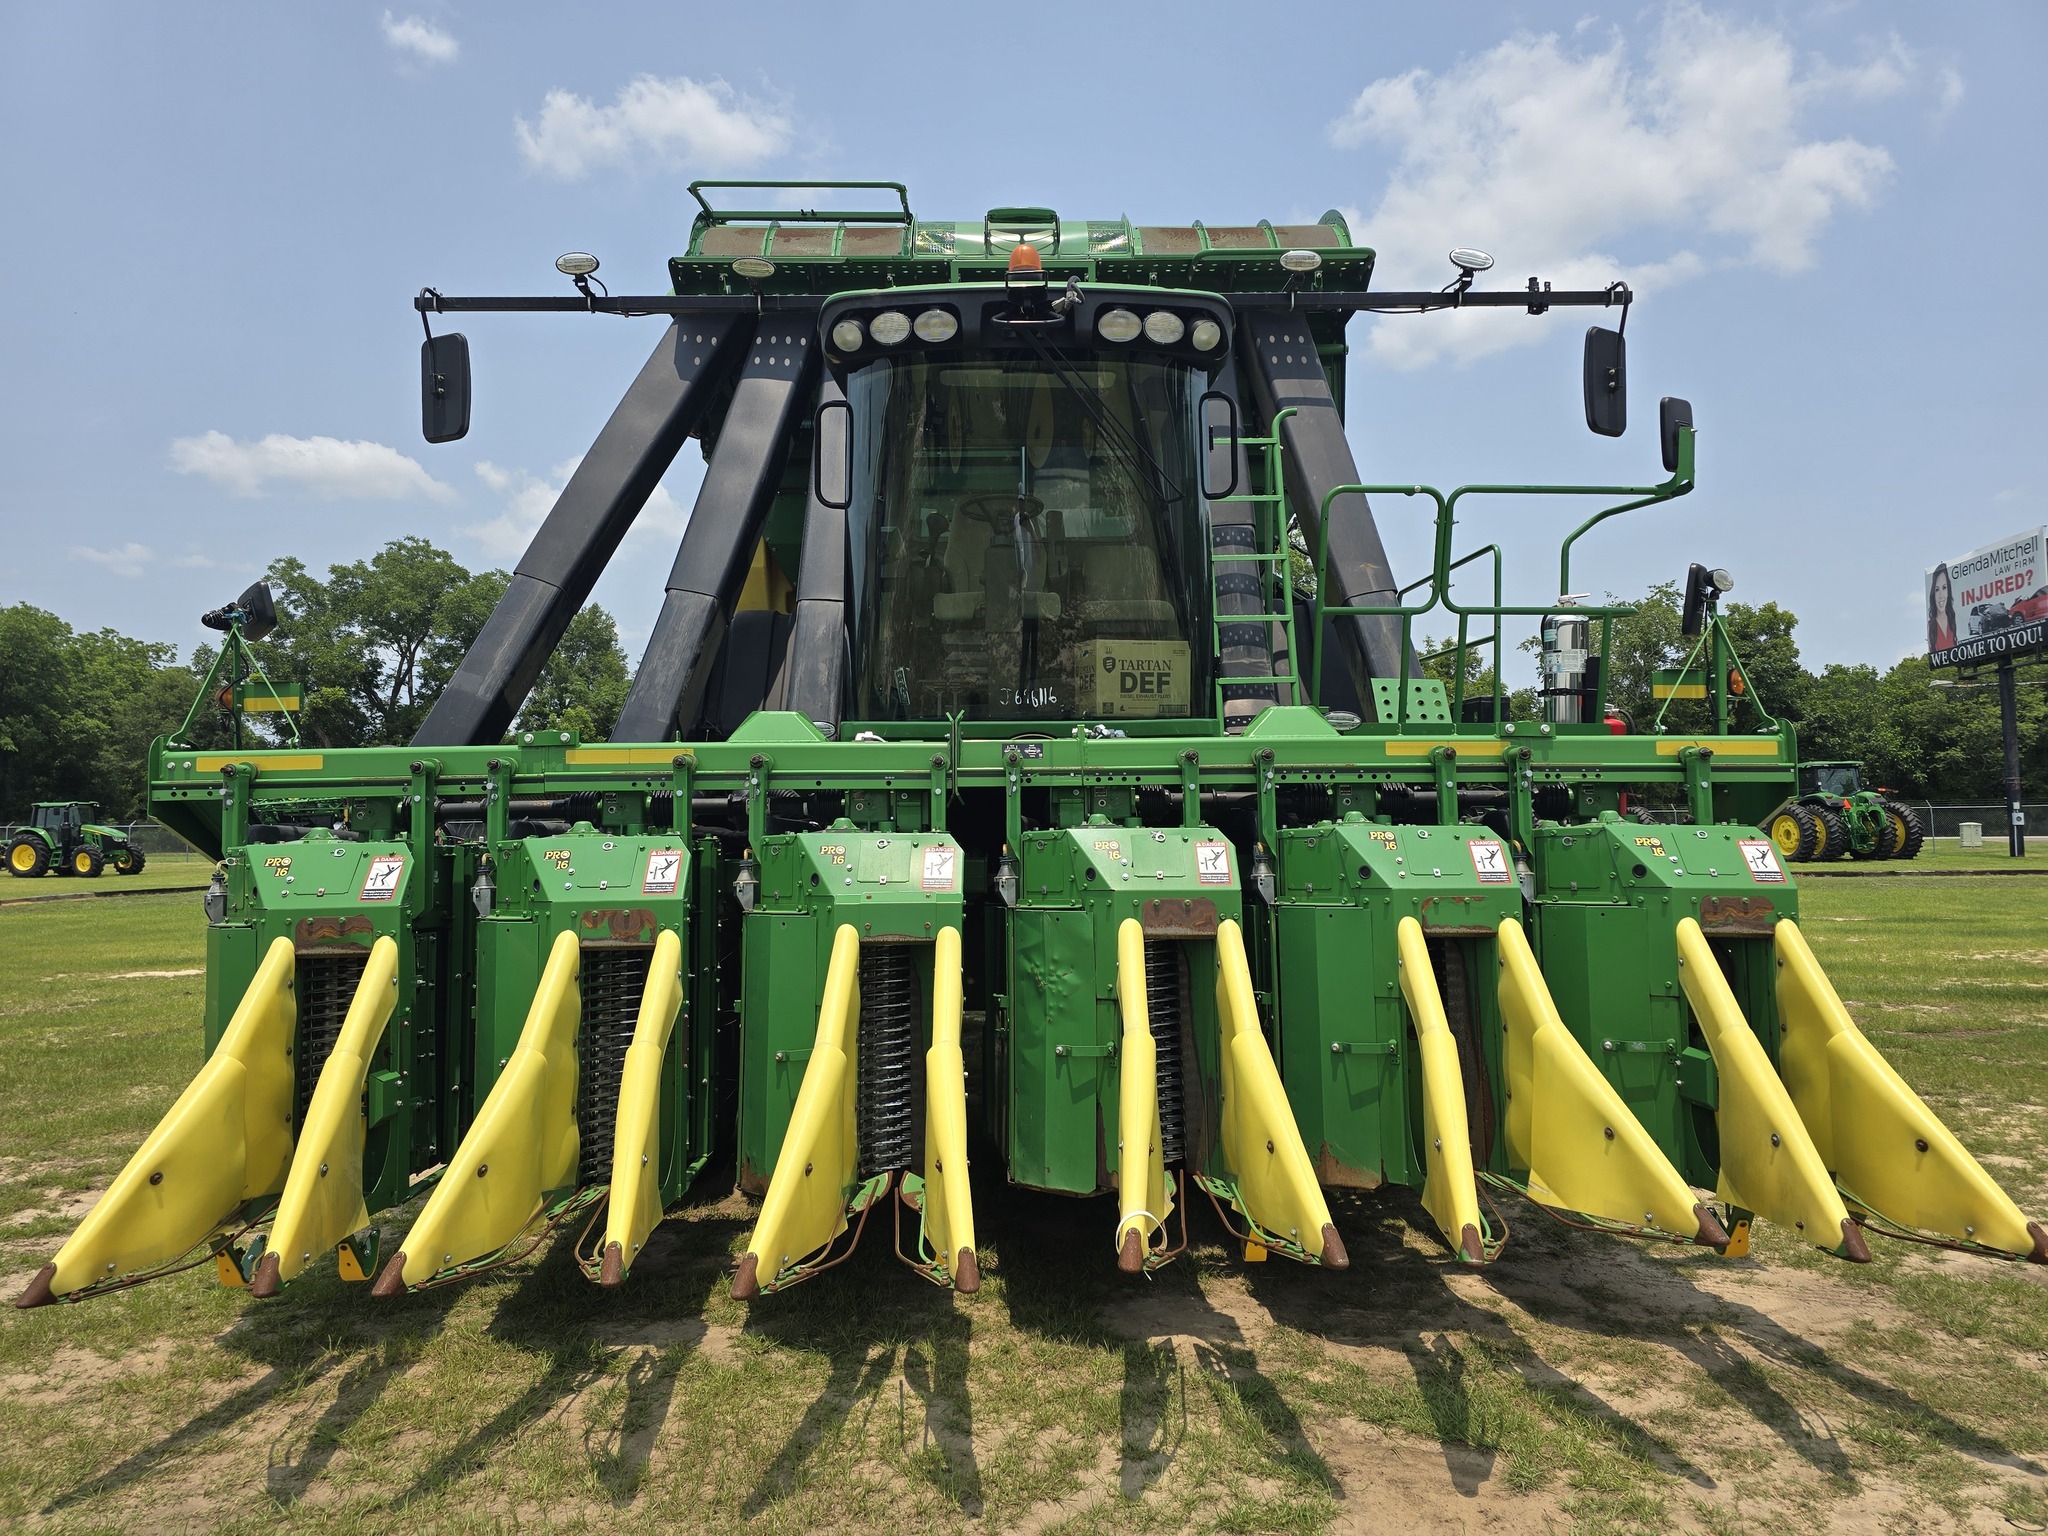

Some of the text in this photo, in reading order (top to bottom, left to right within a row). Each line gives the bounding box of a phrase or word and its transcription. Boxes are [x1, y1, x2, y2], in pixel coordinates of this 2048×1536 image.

[1995, 556, 2035, 577] LAW FIRM
[1961, 569, 2034, 607] INJURED?
[1930, 650, 1949, 667] WE
[1950, 641, 1986, 664] COME
[1987, 636, 2006, 654] TO
[2007, 626, 2043, 649] YOU!
[1118, 660, 1173, 671] TARTAN
[1119, 671, 1171, 693] DEF
[1384, 841, 1398, 850] 16
[1108, 850, 1121, 860] 16
[1651, 847, 1666, 857] 16
[556, 860, 569, 870] 16
[832, 855, 845, 865] 16
[274, 867, 288, 877] 16
